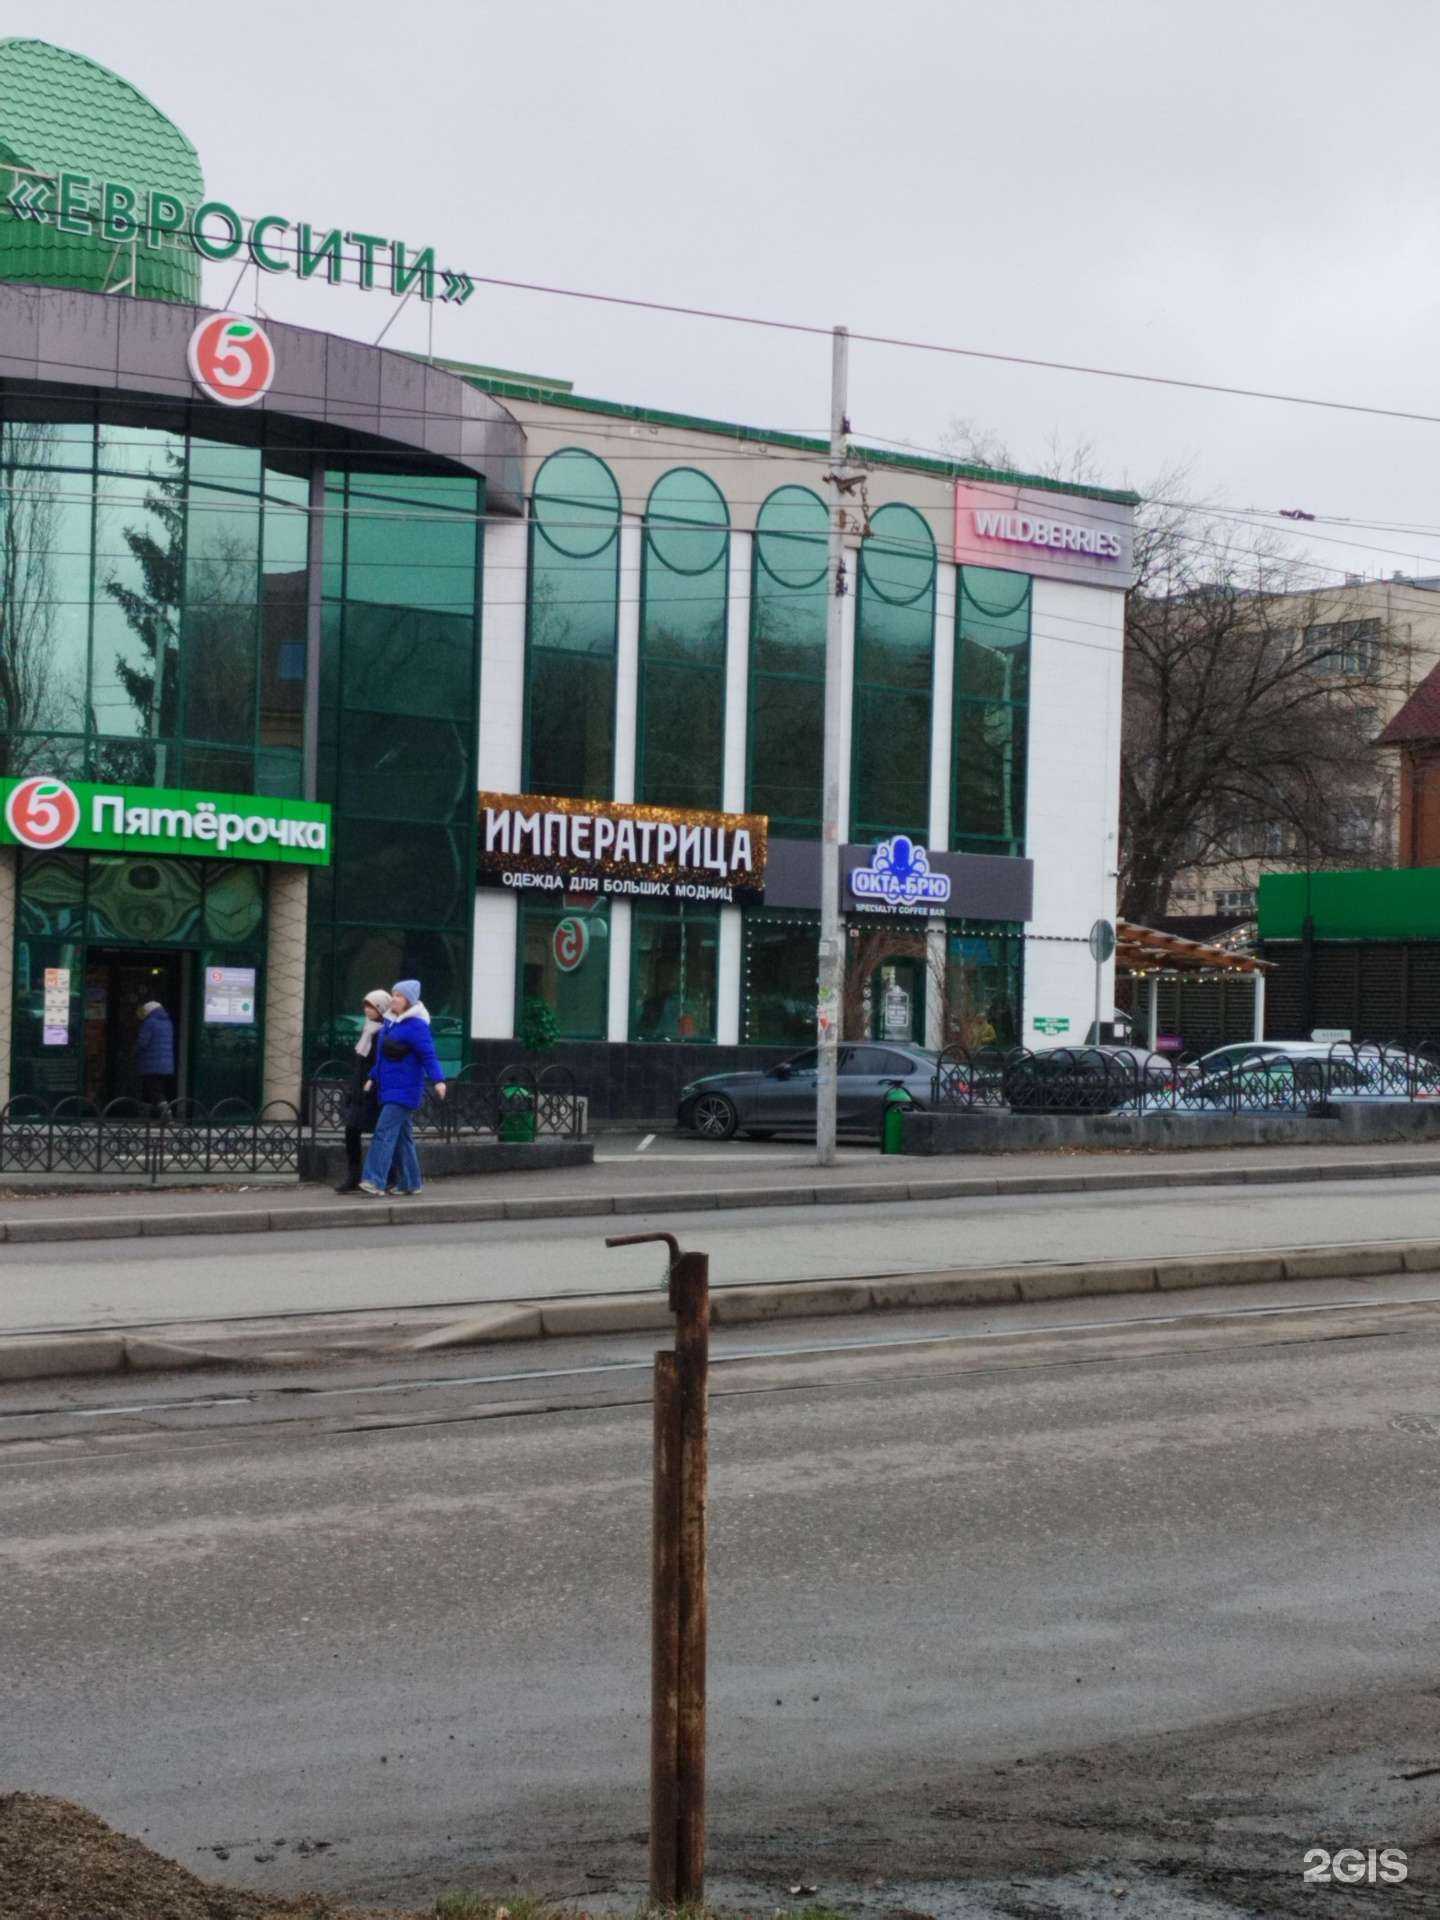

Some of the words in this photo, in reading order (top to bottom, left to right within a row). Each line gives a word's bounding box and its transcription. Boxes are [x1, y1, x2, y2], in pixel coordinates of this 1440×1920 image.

[7, 171, 476, 305] «ЕВРОСИТИ»
[212, 325, 254, 388] 5
[975, 510, 1121, 557] WILDBERRIES
[26, 786, 61, 836] 5
[92, 795, 327, 850] Пятёрочка
[484, 807, 752, 877] ИМПЕРАТРИЦА
[502, 872, 564, 889] ОДЕЖДА
[569, 876, 599, 892] ДЛЯ
[603, 879, 670, 897] БОЛЬШИХ
[675, 884, 734, 902] МОДНИЦ
[856, 873, 946, 896] ОКТА-БРЮ
[856, 903, 897, 913] SPECIALTY
[898, 906, 928, 916] COFFEE
[929, 908, 946, 916] BAR
